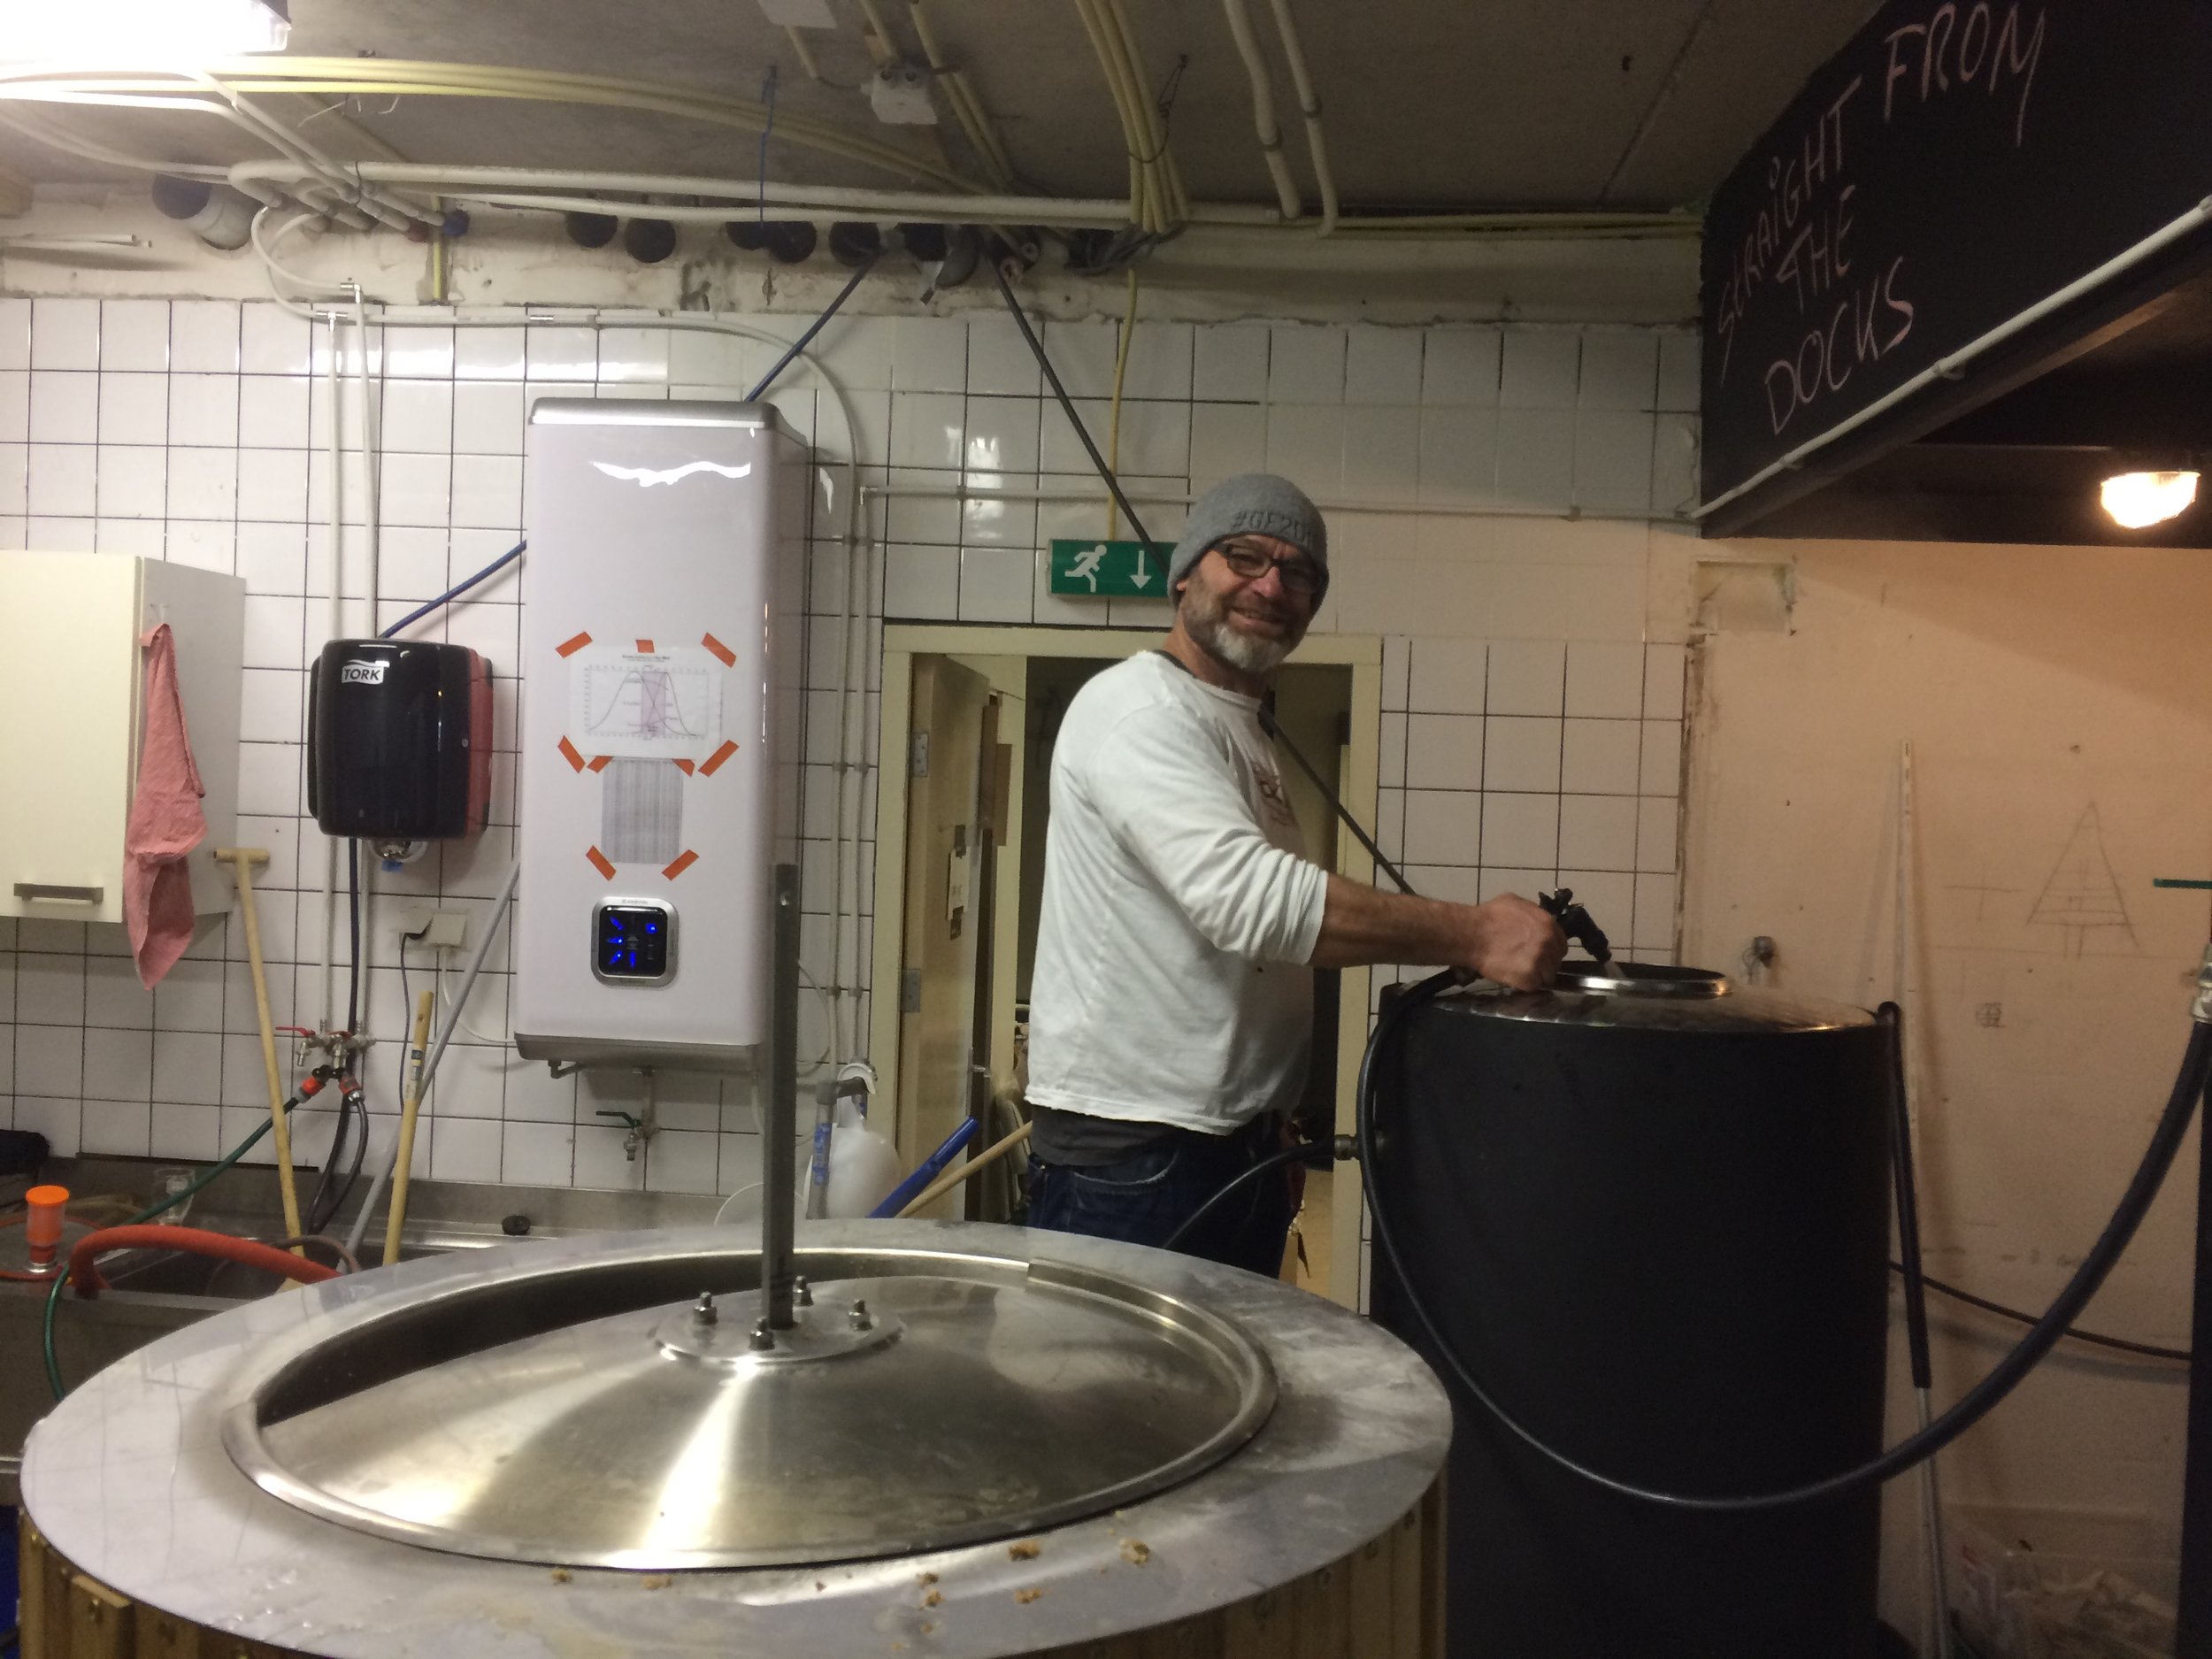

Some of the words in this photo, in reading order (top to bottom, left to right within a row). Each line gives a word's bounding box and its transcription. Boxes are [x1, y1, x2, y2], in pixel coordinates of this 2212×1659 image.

[1884, 1, 2047, 148] FROM
[1776, 184, 1857, 314] THE
[1763, 255, 1915, 436] DOCKS
[344, 668, 381, 680] TORK
